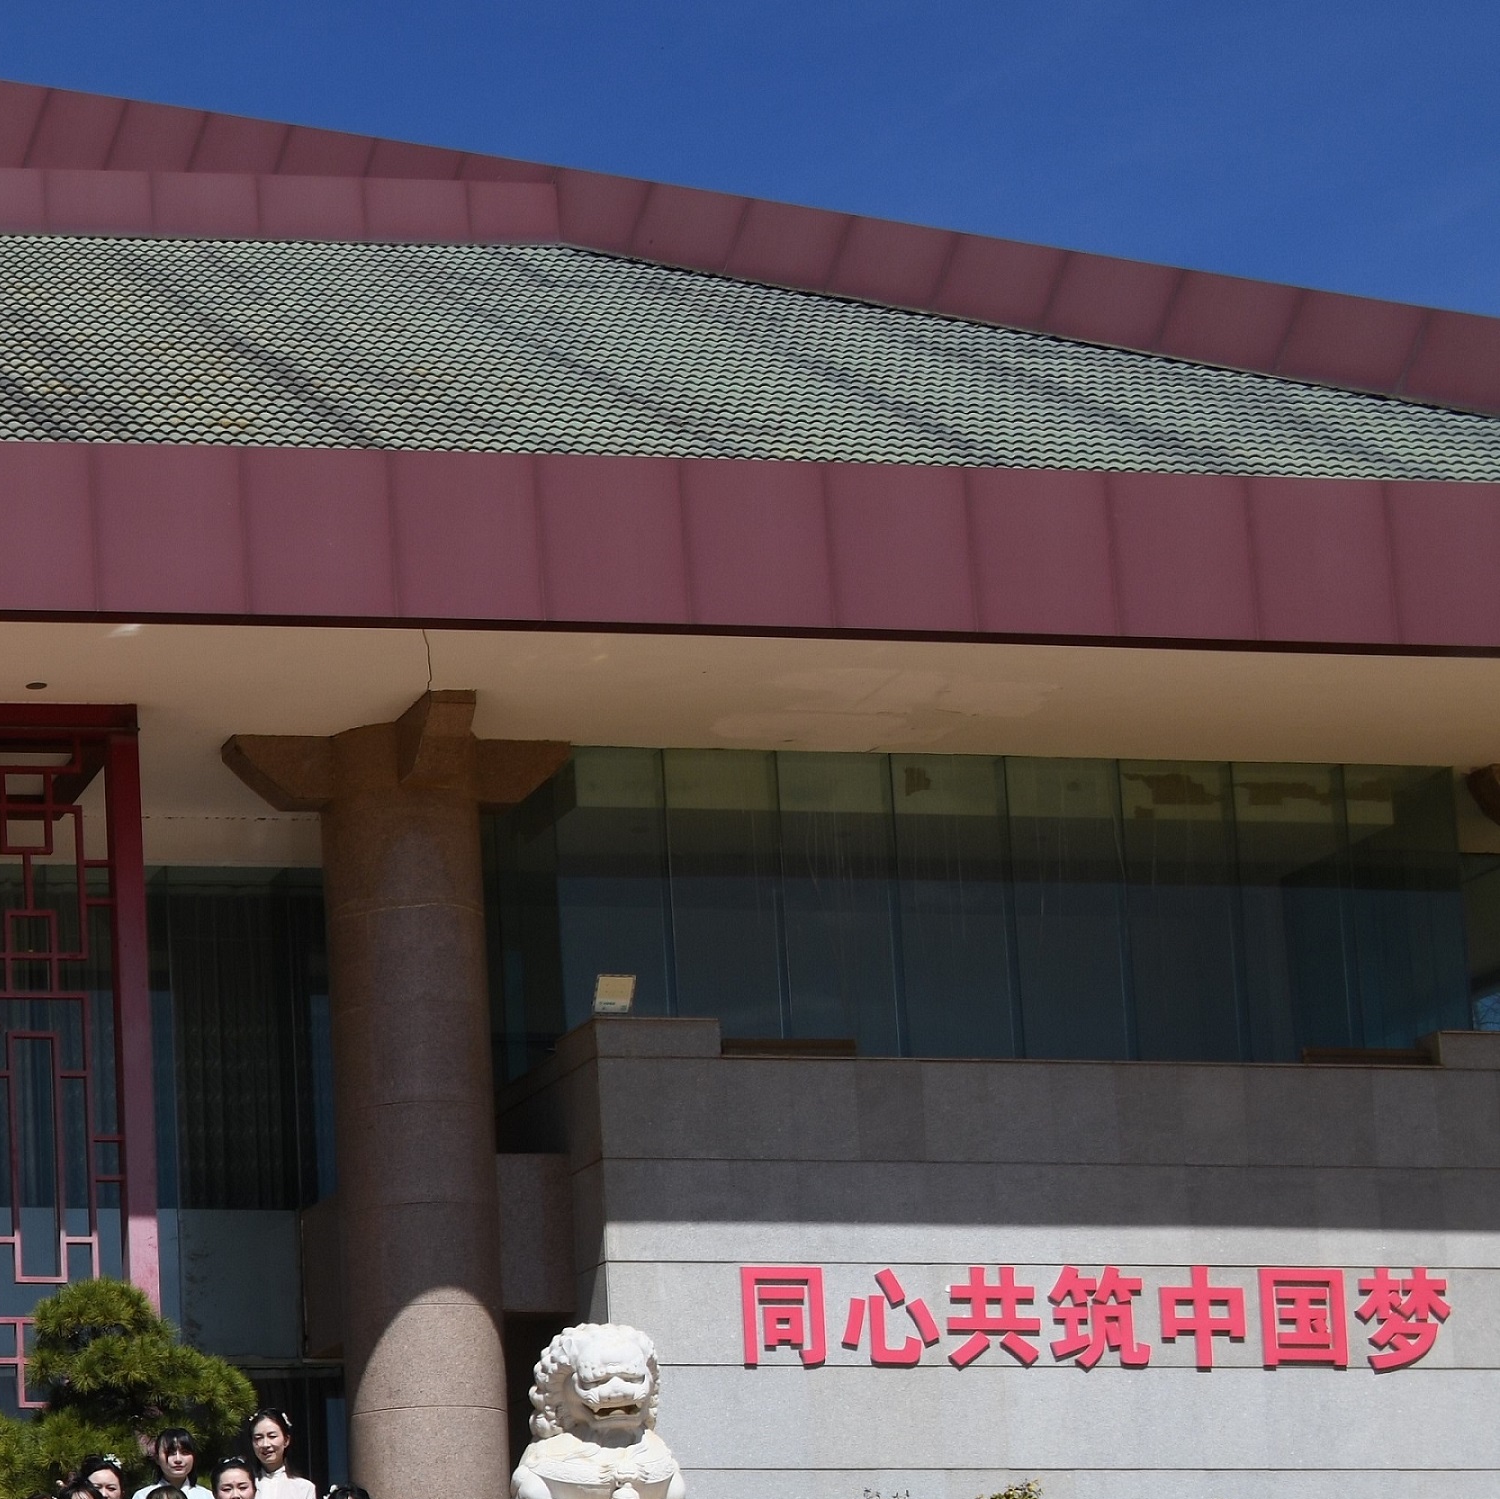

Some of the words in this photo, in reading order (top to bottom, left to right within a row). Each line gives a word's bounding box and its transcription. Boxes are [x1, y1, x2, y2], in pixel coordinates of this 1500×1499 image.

[740, 1265, 1451, 1370] 同心共筑中国梦
